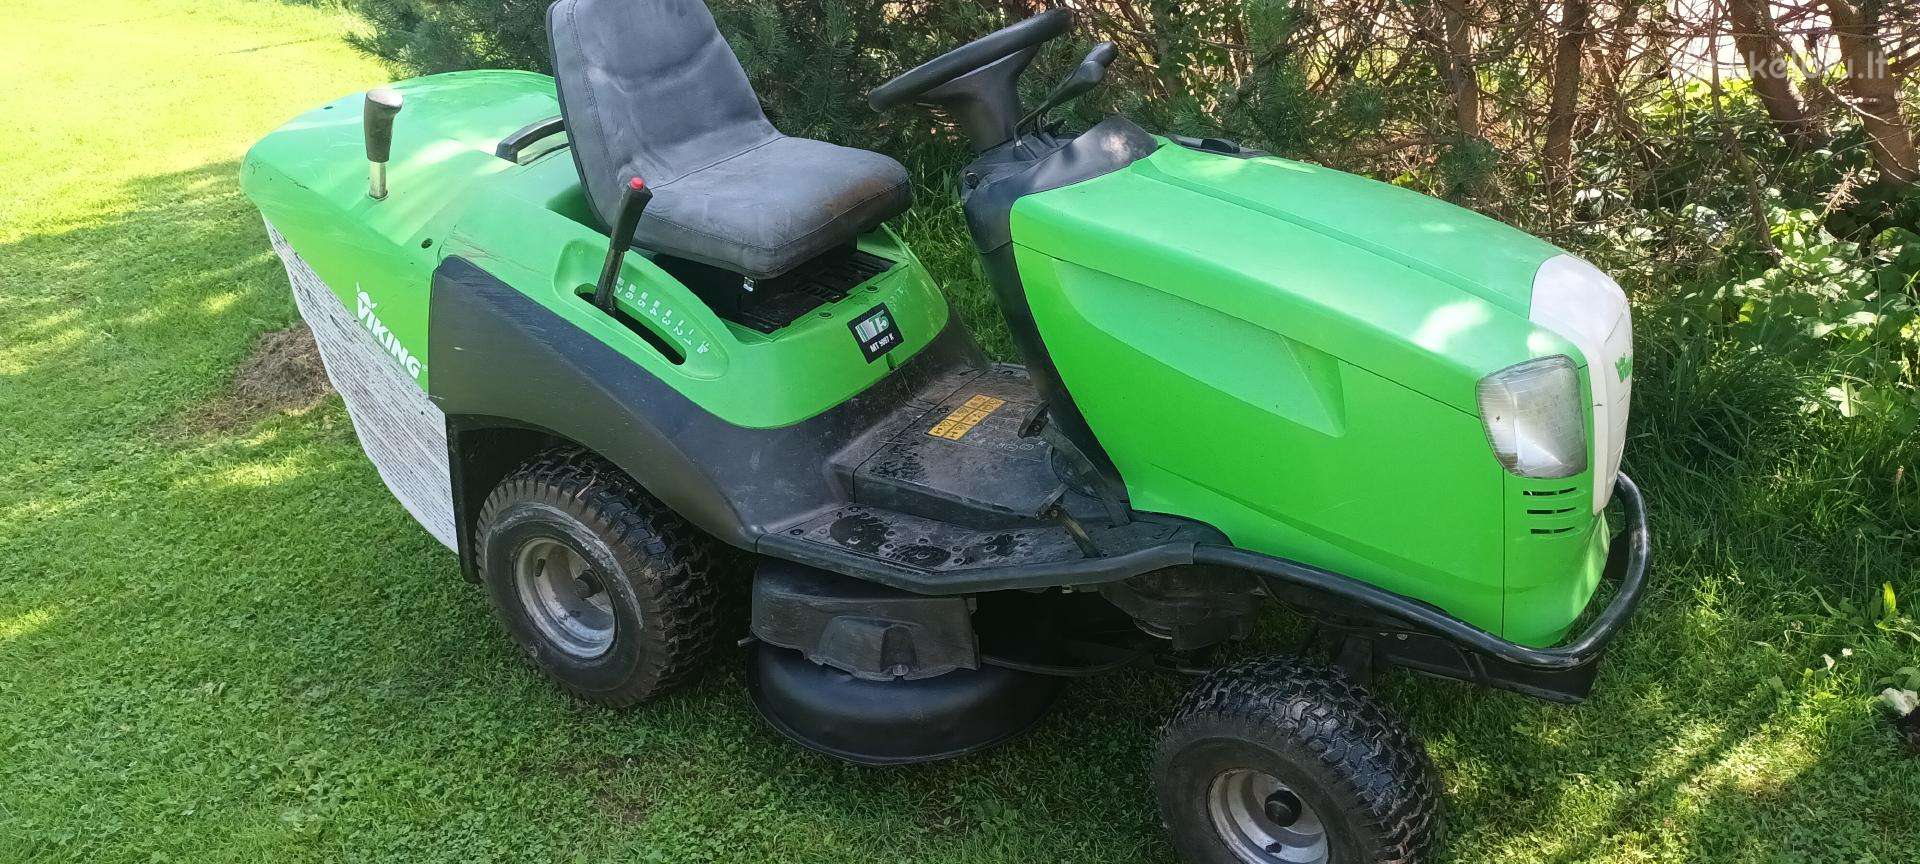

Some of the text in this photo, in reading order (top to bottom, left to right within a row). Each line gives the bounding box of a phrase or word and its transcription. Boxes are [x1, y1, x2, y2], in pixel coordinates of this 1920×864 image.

[357, 295, 422, 380] VIKING
[625, 291, 634, 300] 6
[637, 299, 646, 308] 5
[650, 308, 657, 316] 4
[662, 317, 671, 325] 3
[673, 326, 683, 336] 2
